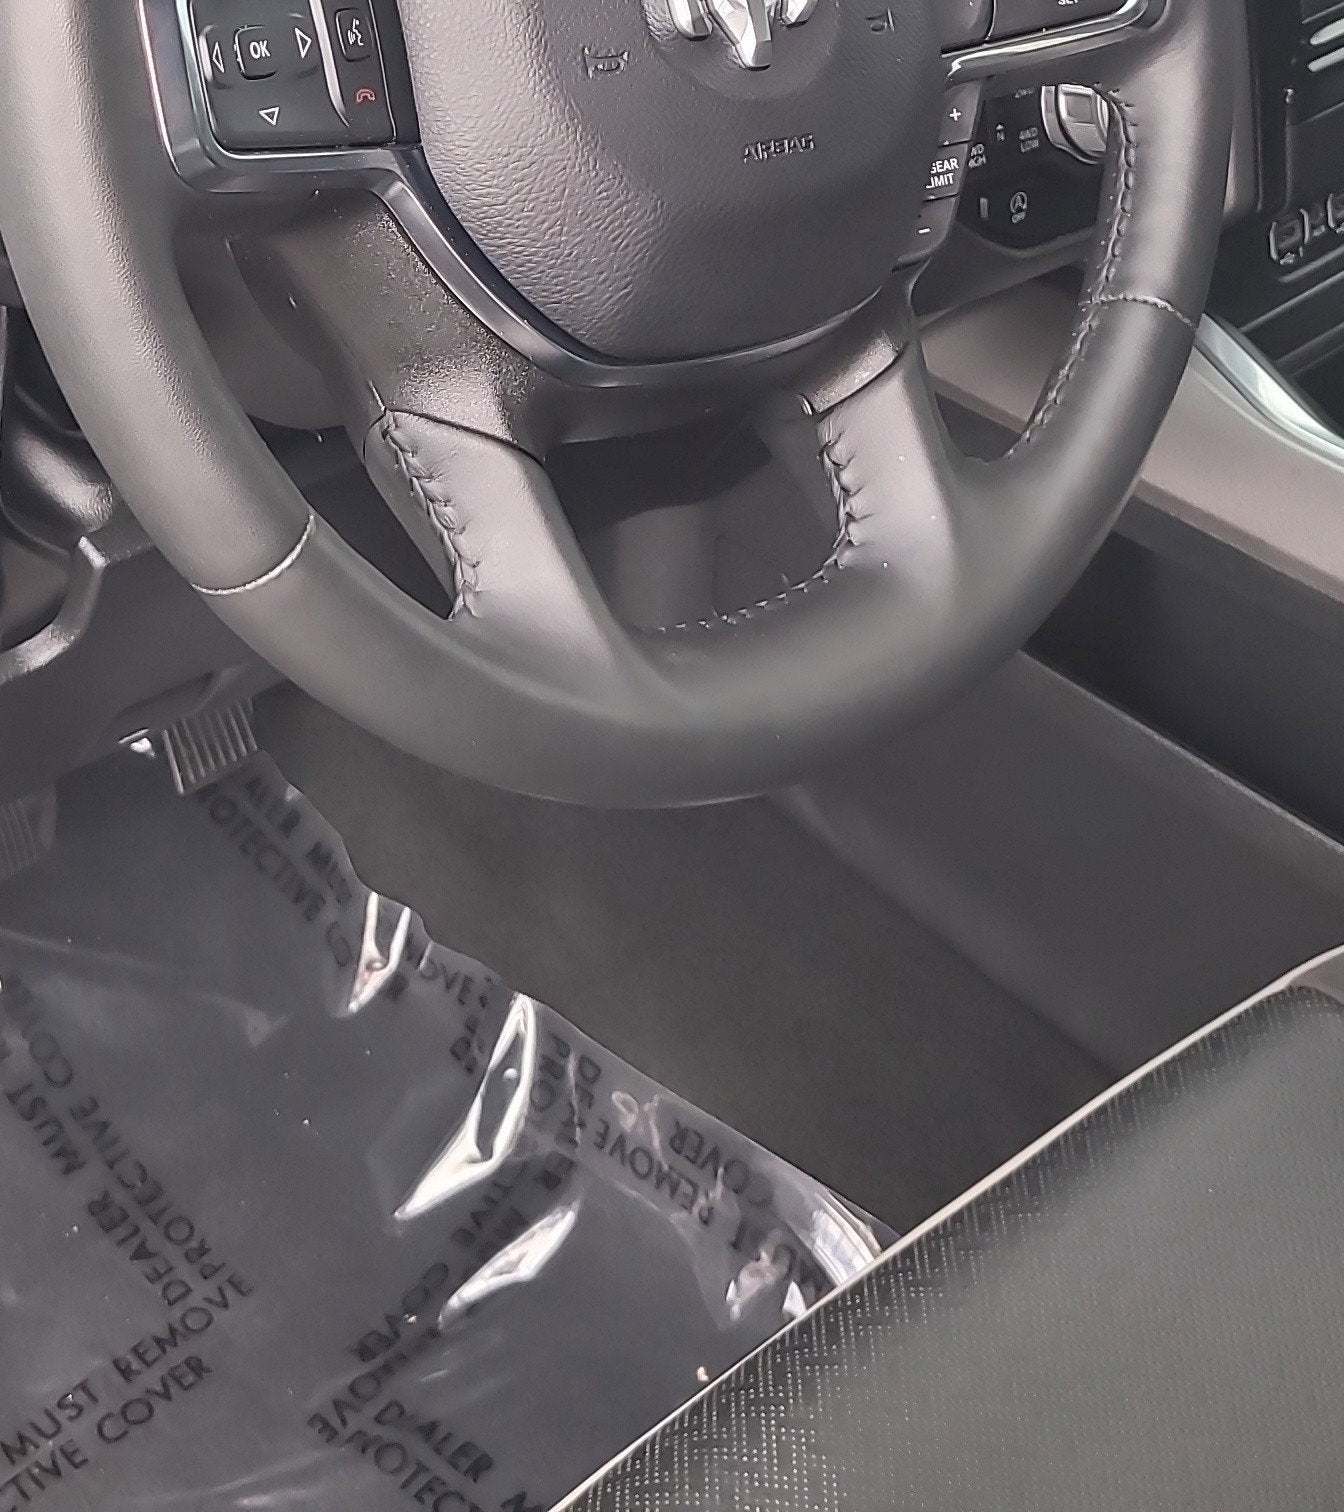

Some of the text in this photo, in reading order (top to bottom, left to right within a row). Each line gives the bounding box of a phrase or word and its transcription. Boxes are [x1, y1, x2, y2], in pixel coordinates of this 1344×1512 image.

[249, 39, 271, 59] OK
[4, 1083, 88, 1176] MUST
[69, 1096, 227, 1280] PROTECTIVE
[88, 1190, 193, 1307] DEALER
[0, 1378, 99, 1466] MUST
[112, 1272, 256, 1384] REMOVE
[97, 1355, 213, 1445] COVER
